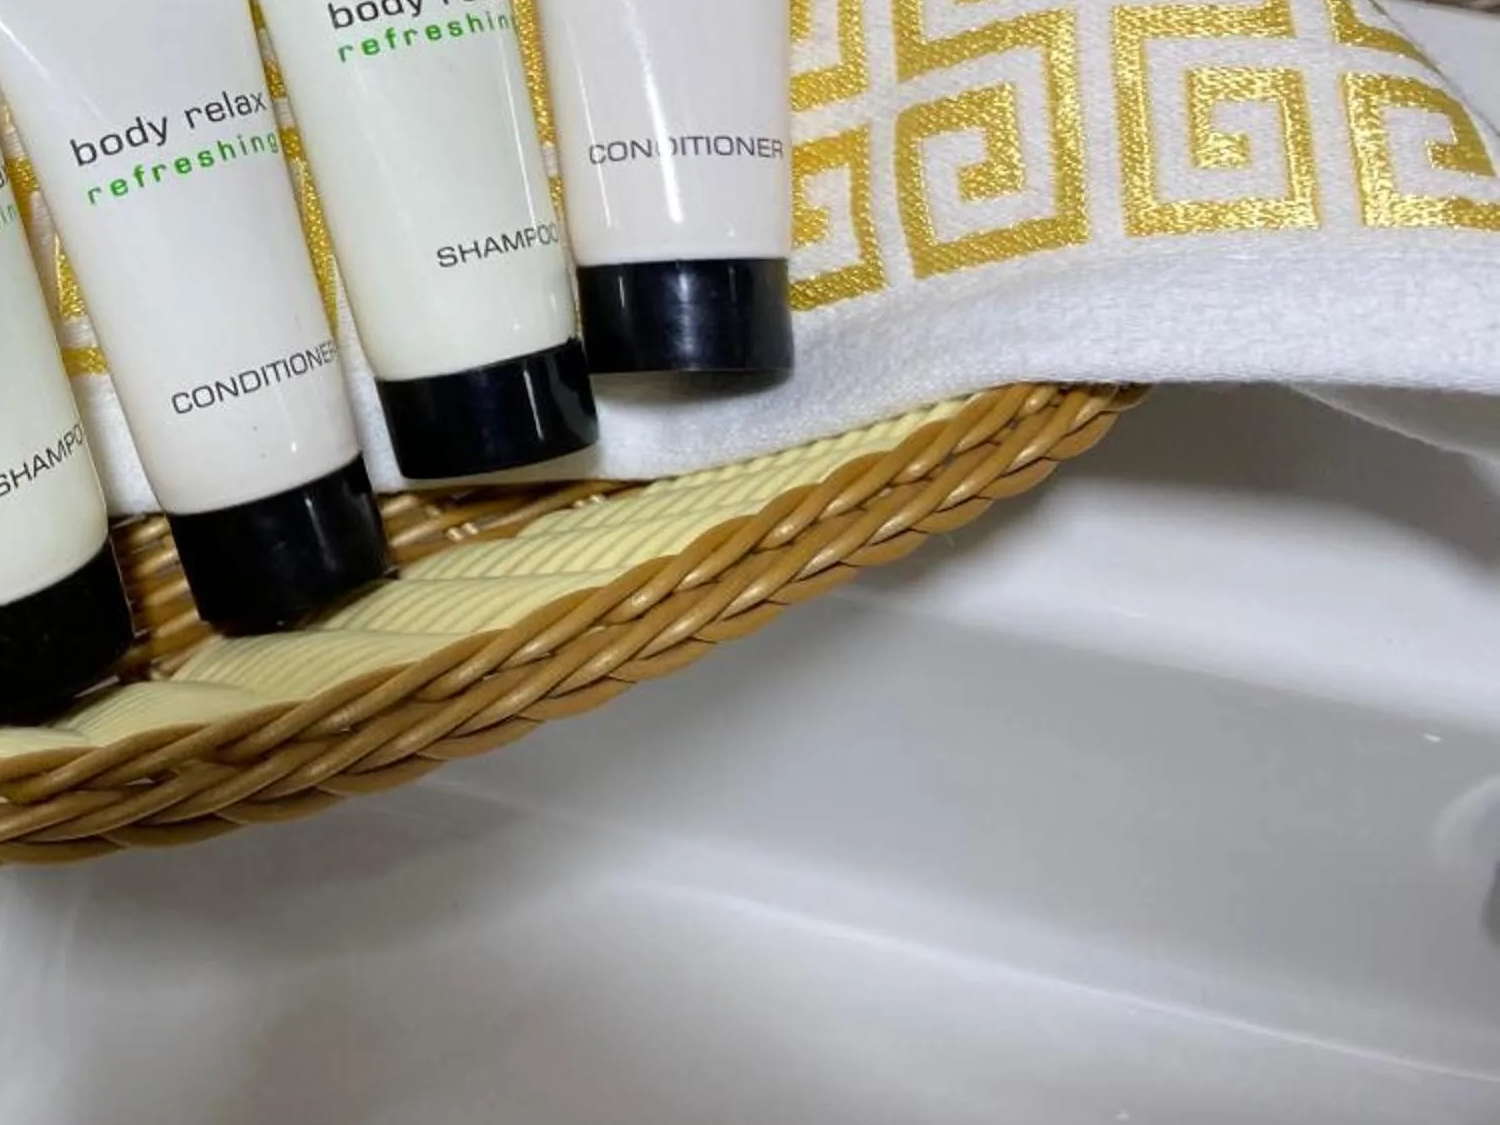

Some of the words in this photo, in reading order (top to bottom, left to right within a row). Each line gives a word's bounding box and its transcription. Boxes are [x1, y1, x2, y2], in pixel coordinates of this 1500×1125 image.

[337, 9, 514, 63] refreshin
[69, 116, 169, 167] body
[184, 89, 268, 131] relax
[87, 130, 279, 205] refreshing
